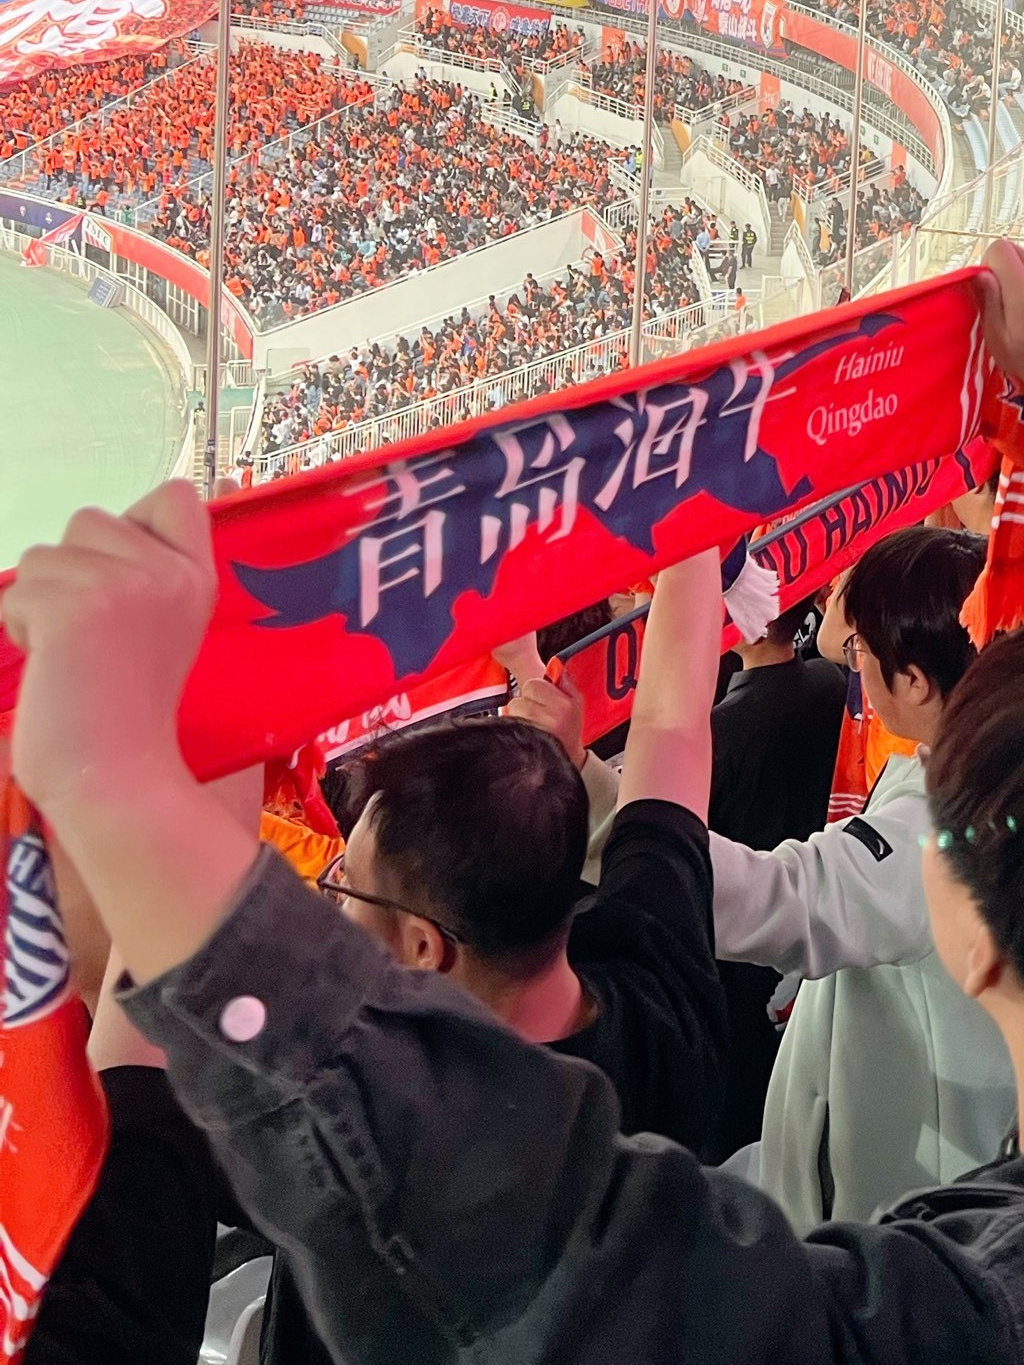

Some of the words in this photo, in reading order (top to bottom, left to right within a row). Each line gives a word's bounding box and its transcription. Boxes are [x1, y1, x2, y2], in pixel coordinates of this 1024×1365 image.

[833, 340, 905, 385] Hainiu
[806, 388, 898, 445] Qingdao
[342, 349, 798, 628] 青岛海牛
